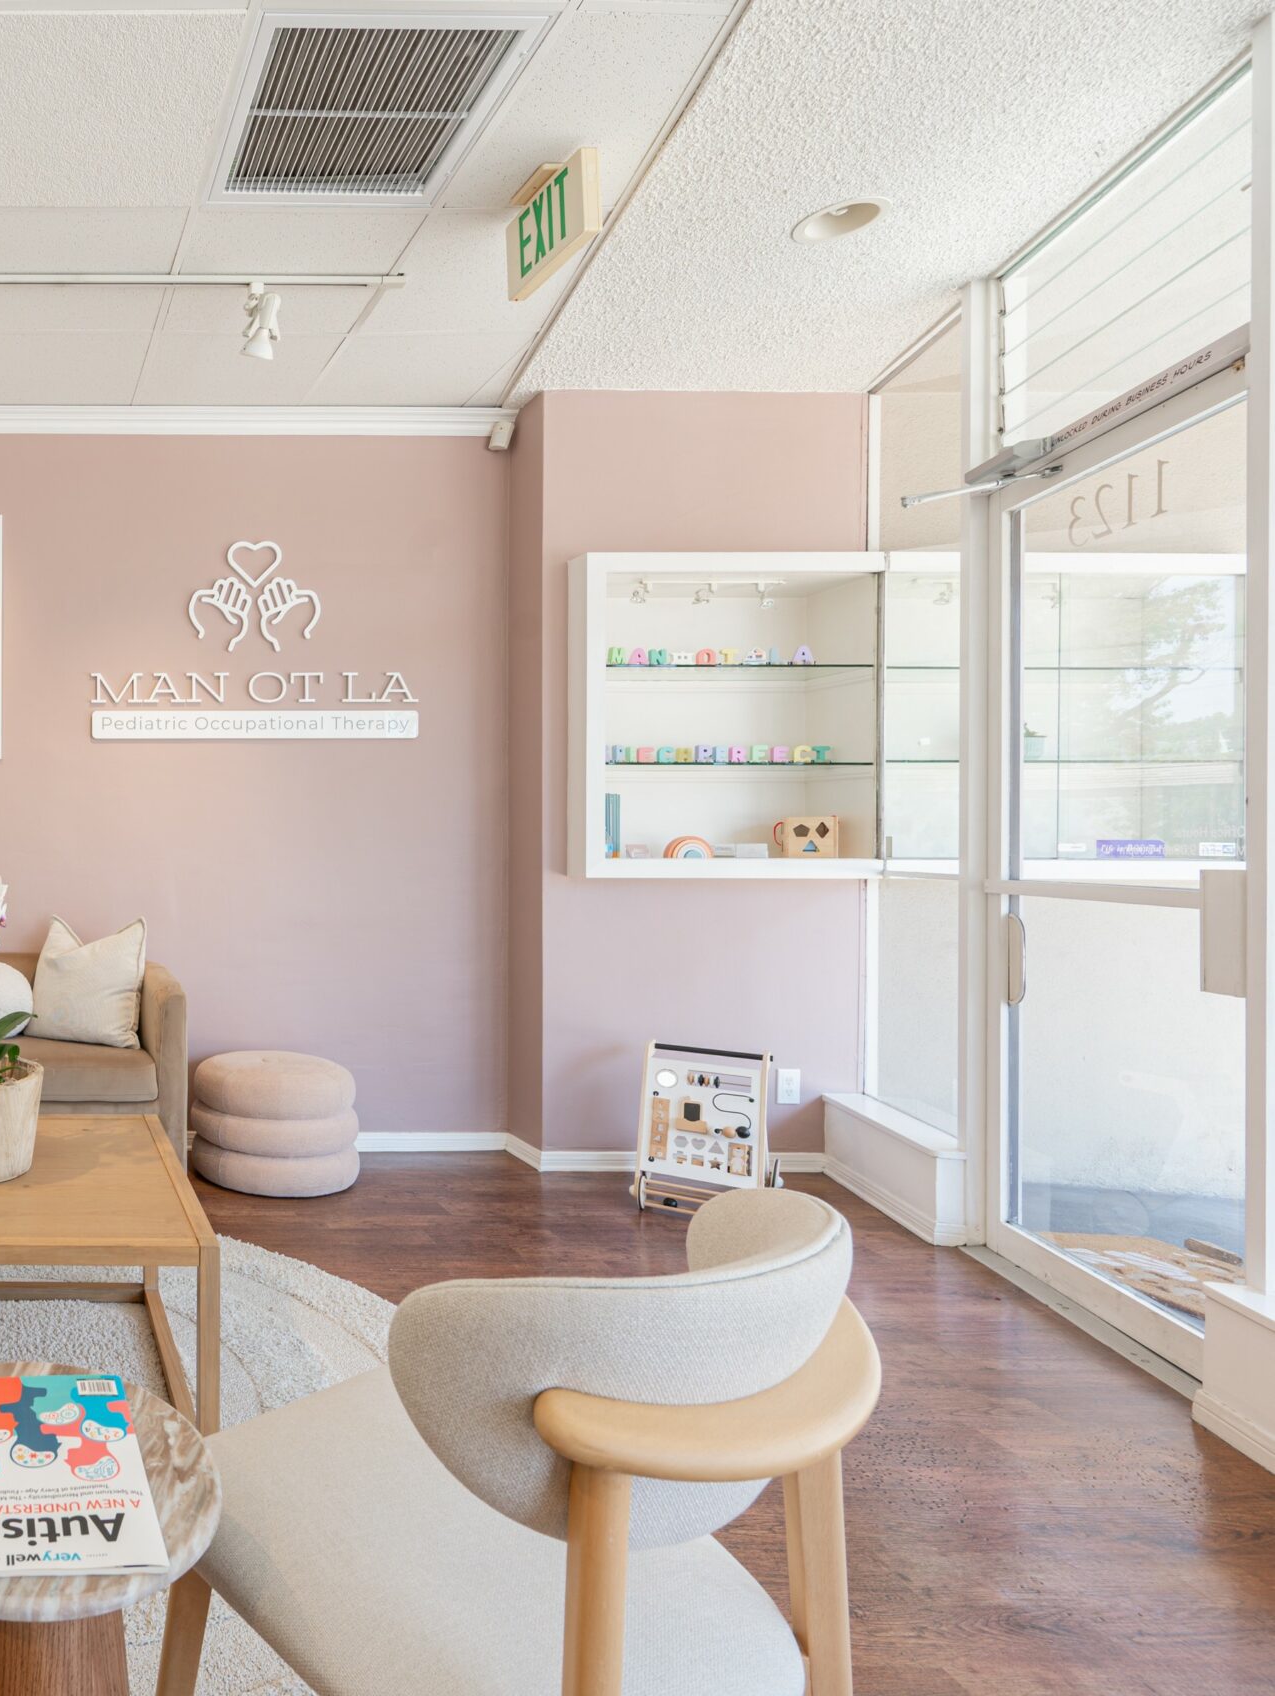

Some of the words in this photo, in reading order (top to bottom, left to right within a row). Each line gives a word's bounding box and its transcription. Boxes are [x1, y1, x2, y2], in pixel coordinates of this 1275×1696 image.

[518, 166, 569, 279] EXIT
[1051, 421, 1088, 447] UNLOCKED
[1091, 402, 1122, 425] DURING
[1125, 373, 1169, 406] BUSINESS
[1172, 350, 1212, 378] HOURS
[607, 646, 668, 665] MAN
[90, 671, 230, 704] MAN
[247, 671, 324, 703] OT
[341, 671, 420, 703] LA
[101, 716, 189, 731] Pediatric
[194, 716, 325, 733] Occupational
[331, 716, 411, 733] Therapy
[694, 744, 831, 763] PERFECT
[86, 1498, 125, 1510] NEW
[129, 1498, 141, 1509] A
[6, 1550, 82, 1566] verywell
